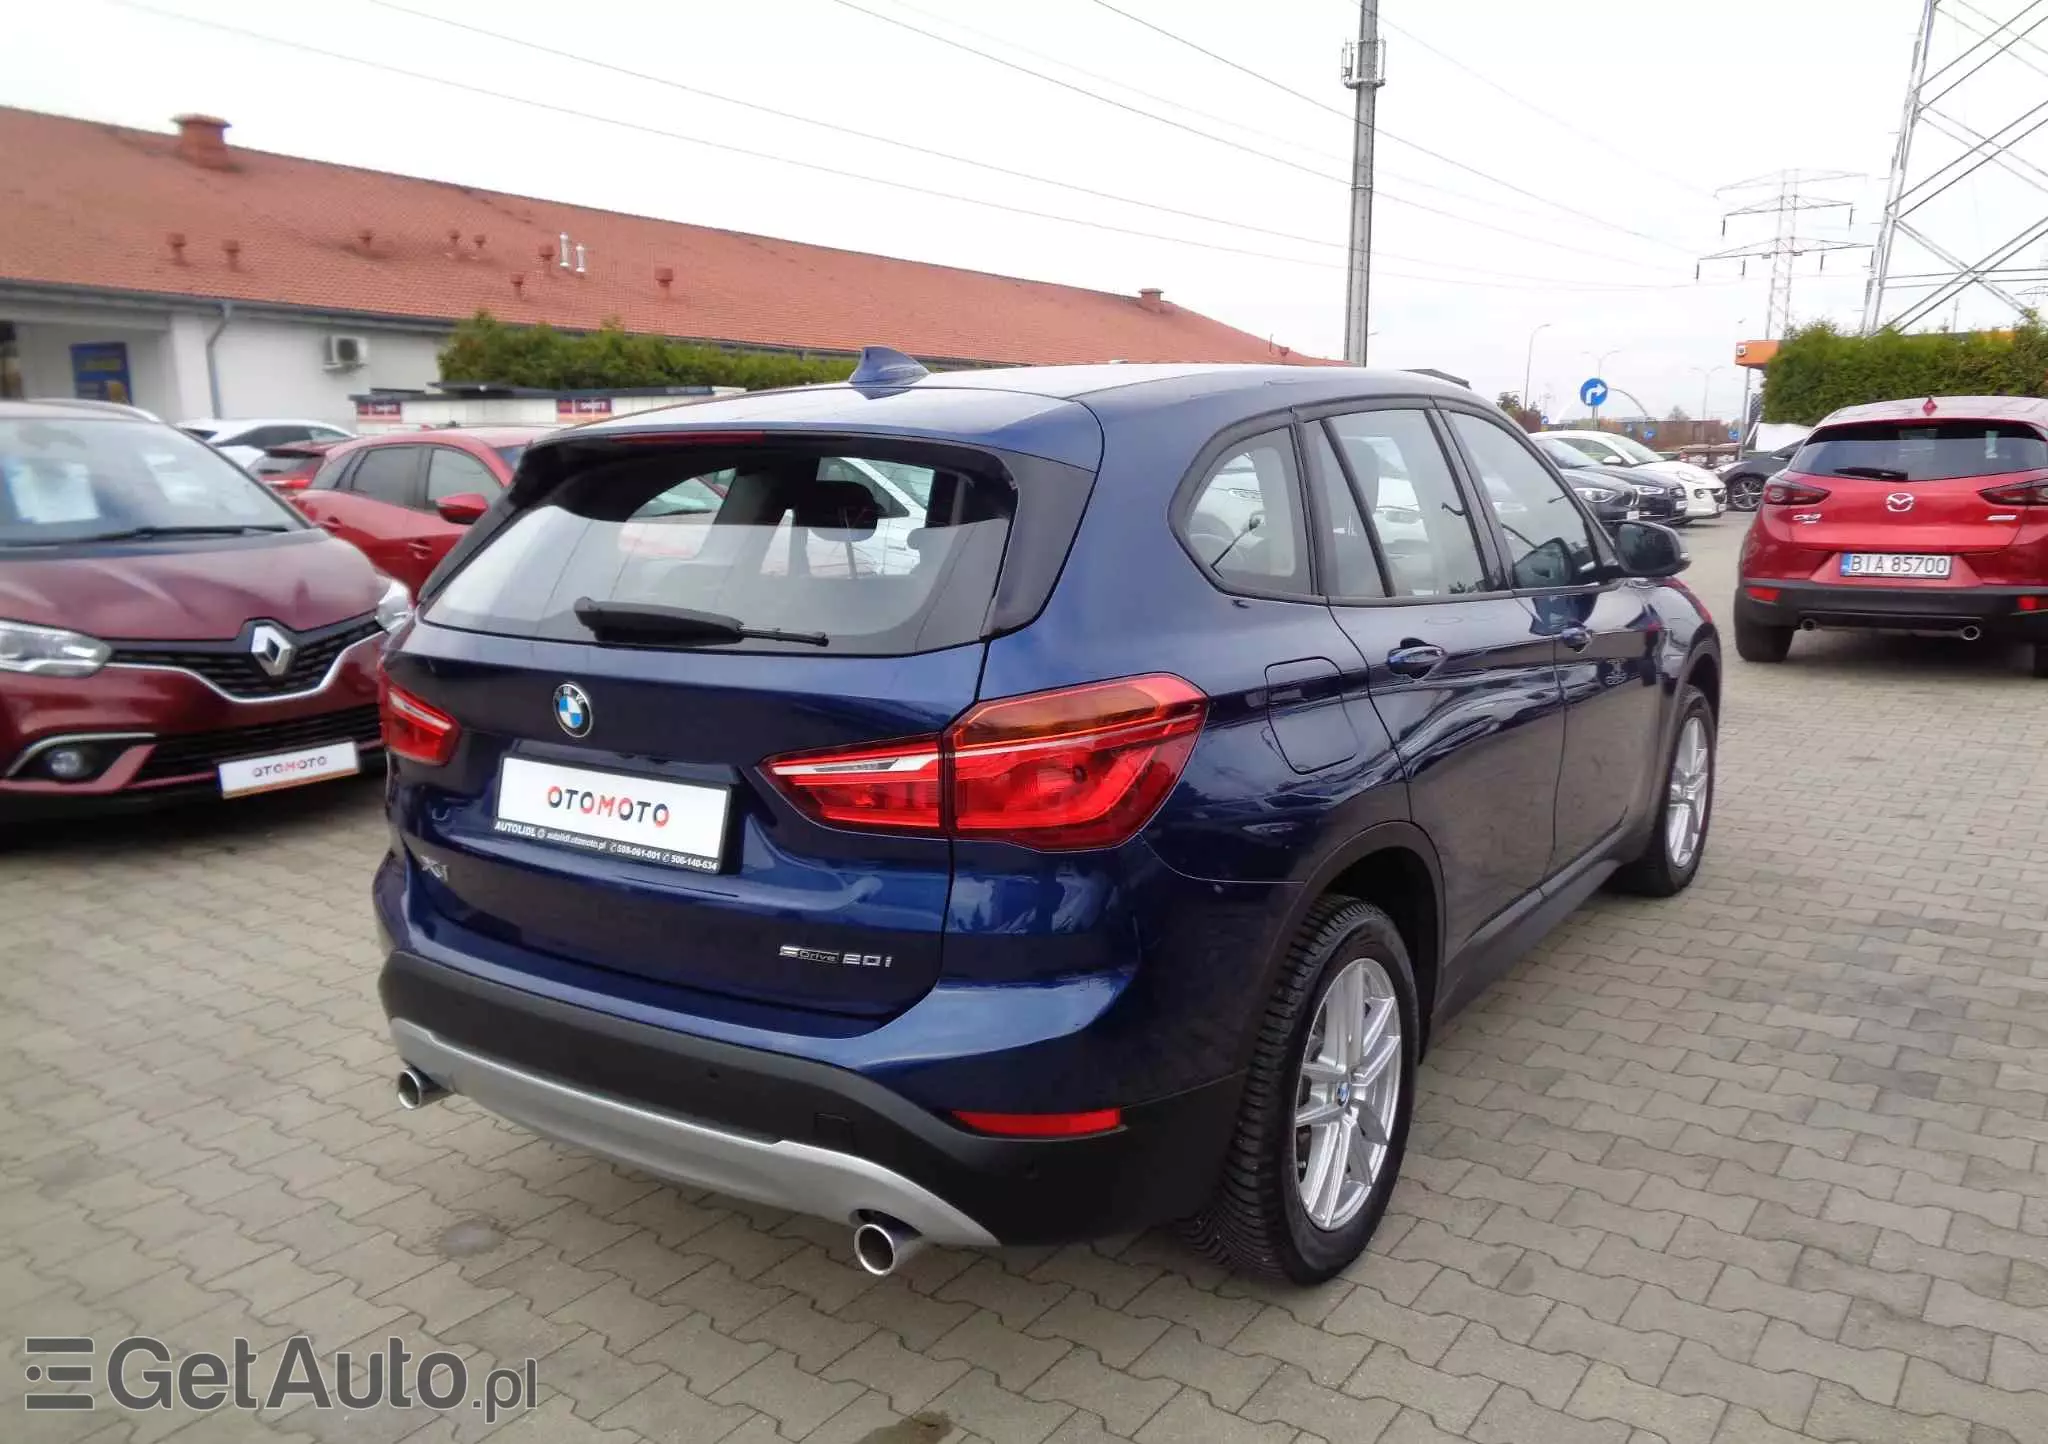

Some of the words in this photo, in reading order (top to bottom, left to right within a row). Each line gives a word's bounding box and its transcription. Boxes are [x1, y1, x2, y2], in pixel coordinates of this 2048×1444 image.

[1851, 555, 1885, 572] BIA
[1891, 556, 1948, 574] 85700
[252, 755, 328, 778] OTOMOTO
[546, 785, 670, 828] OTOMOTO
